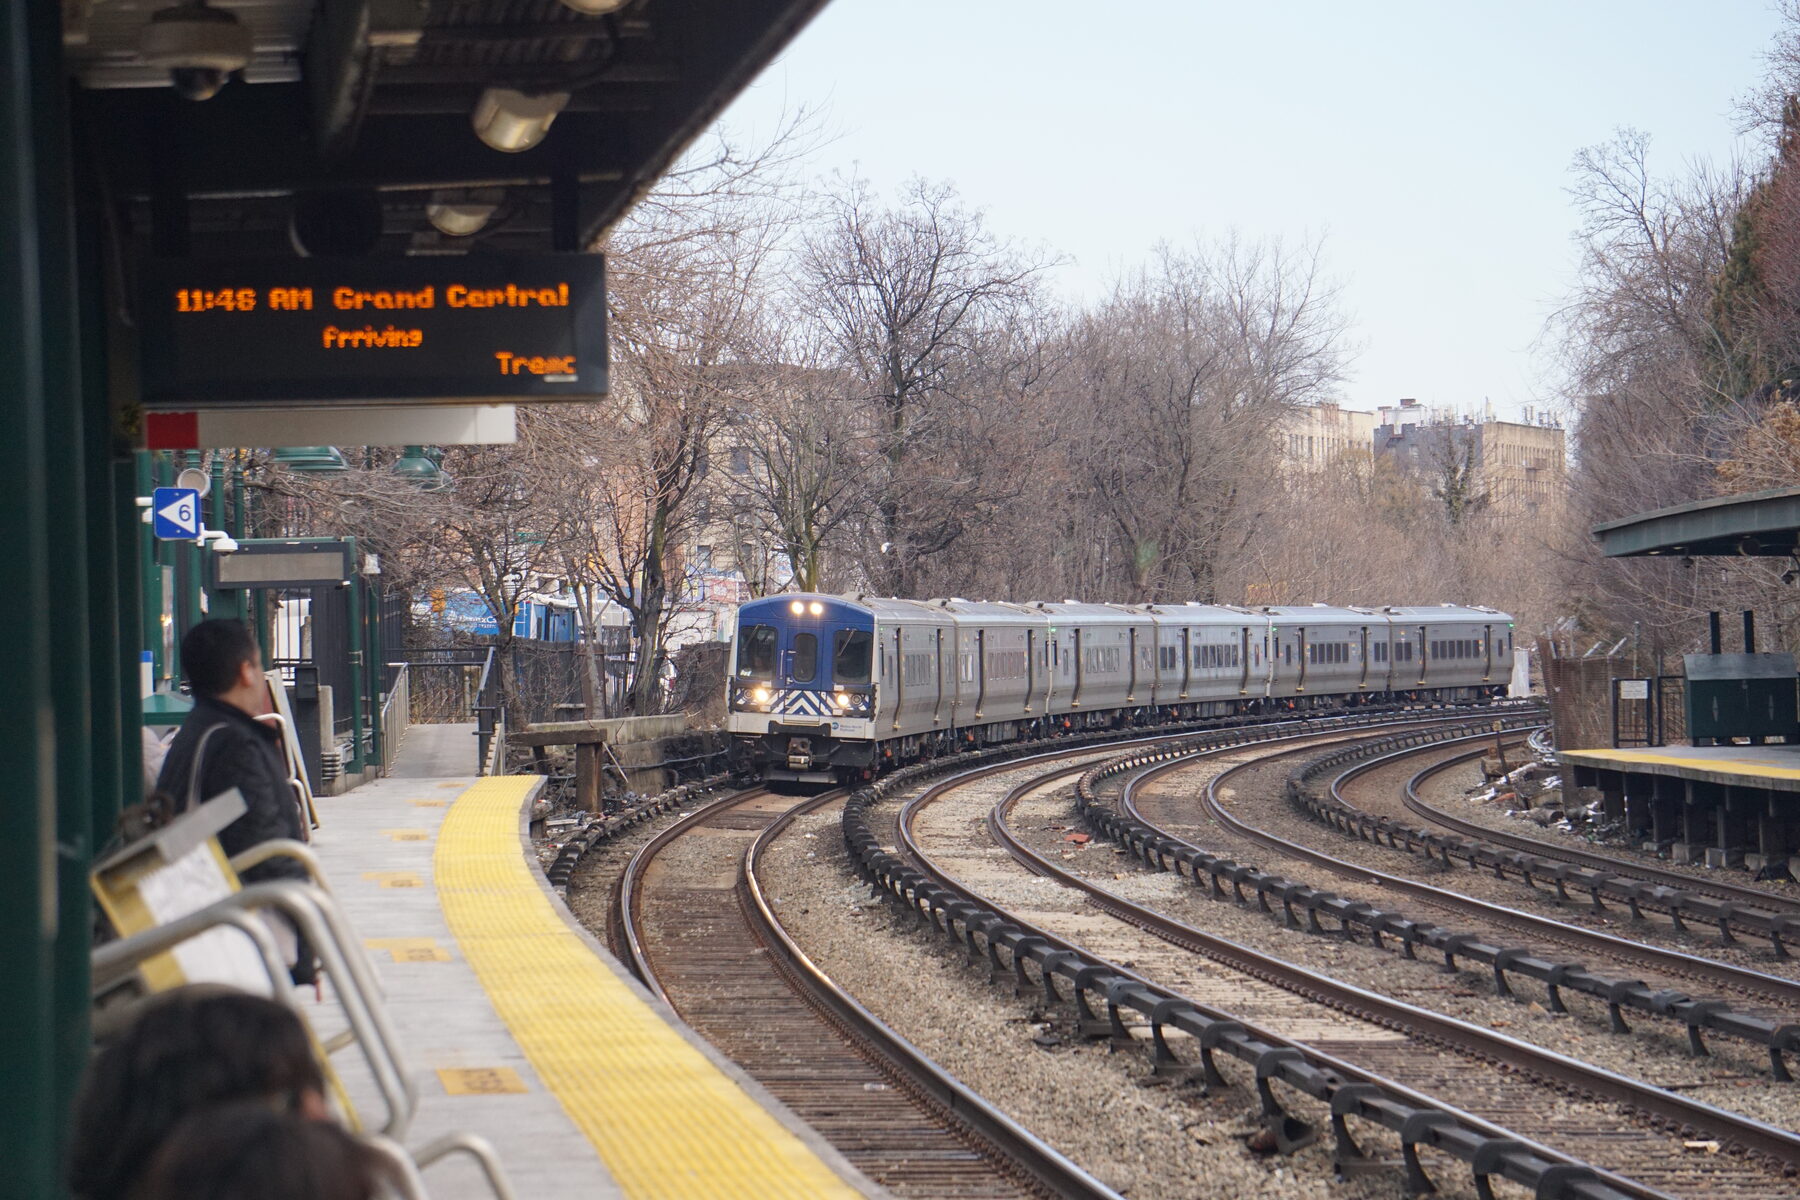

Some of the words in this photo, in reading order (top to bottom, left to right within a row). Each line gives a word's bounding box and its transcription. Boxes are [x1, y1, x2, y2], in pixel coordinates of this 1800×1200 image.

[268, 286, 314, 311] AM
[332, 284, 436, 311] Grand
[446, 282, 570, 308] Central
[179, 504, 192, 522] 6
